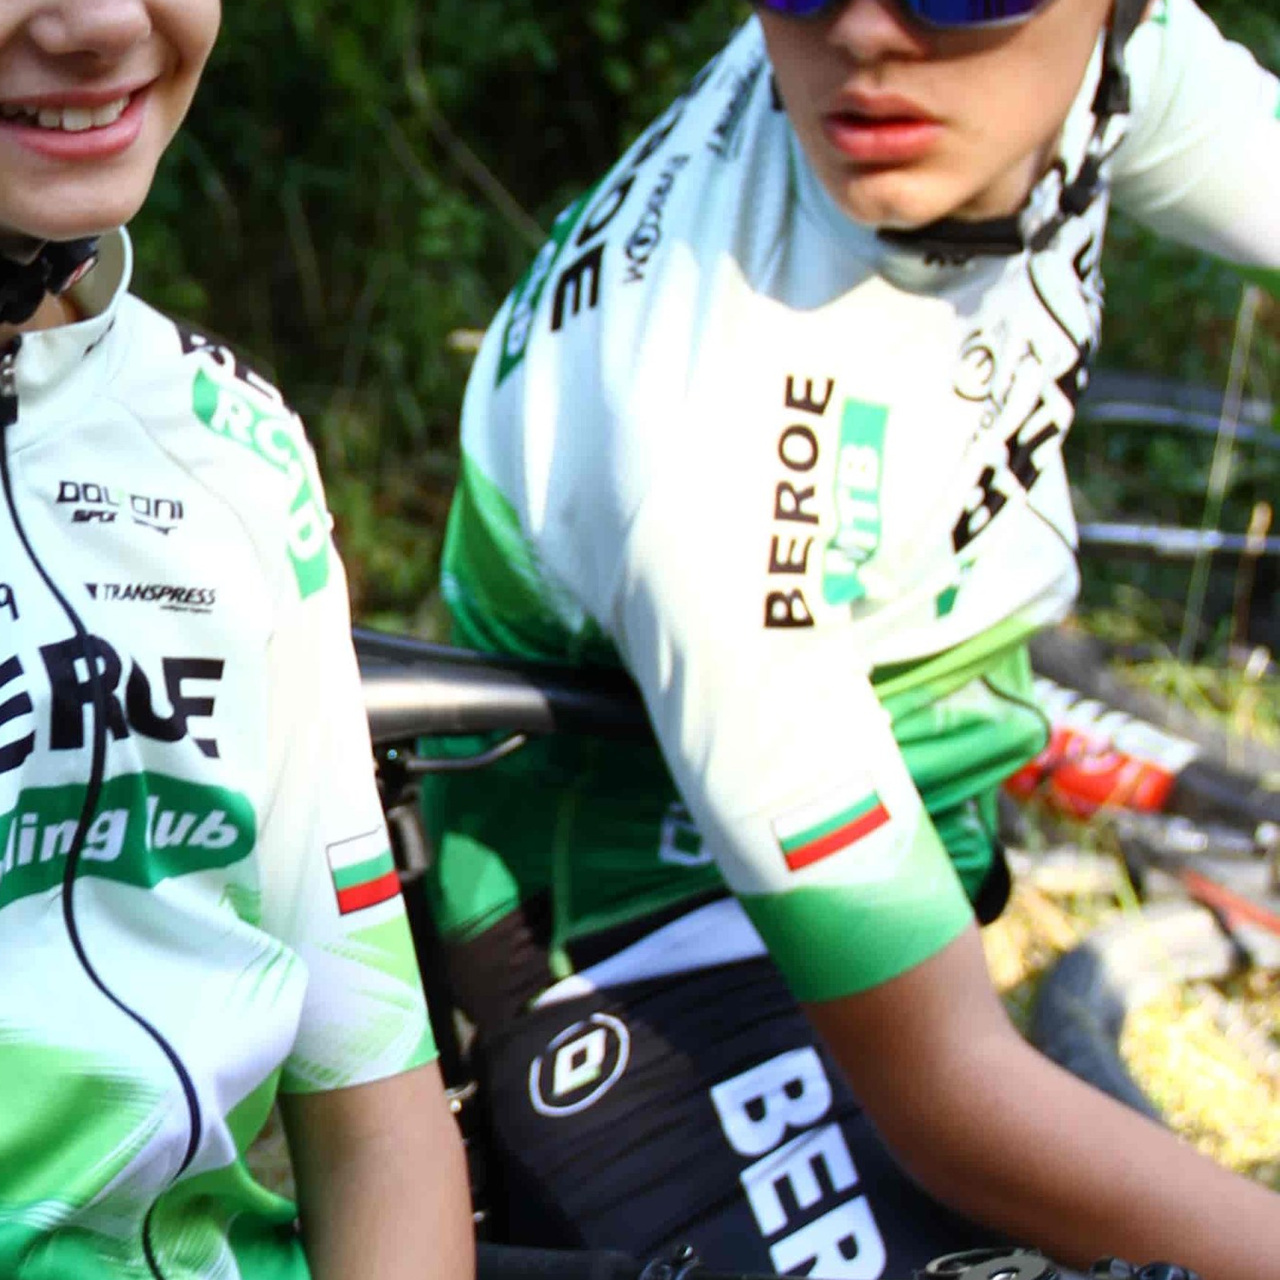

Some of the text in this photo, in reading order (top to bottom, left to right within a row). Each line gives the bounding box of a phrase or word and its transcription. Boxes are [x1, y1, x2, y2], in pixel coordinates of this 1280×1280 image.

[763, 374, 835, 629] BEROE
[102, 582, 217, 606] TRANSPRESS
[144, 794, 238, 852] lub
